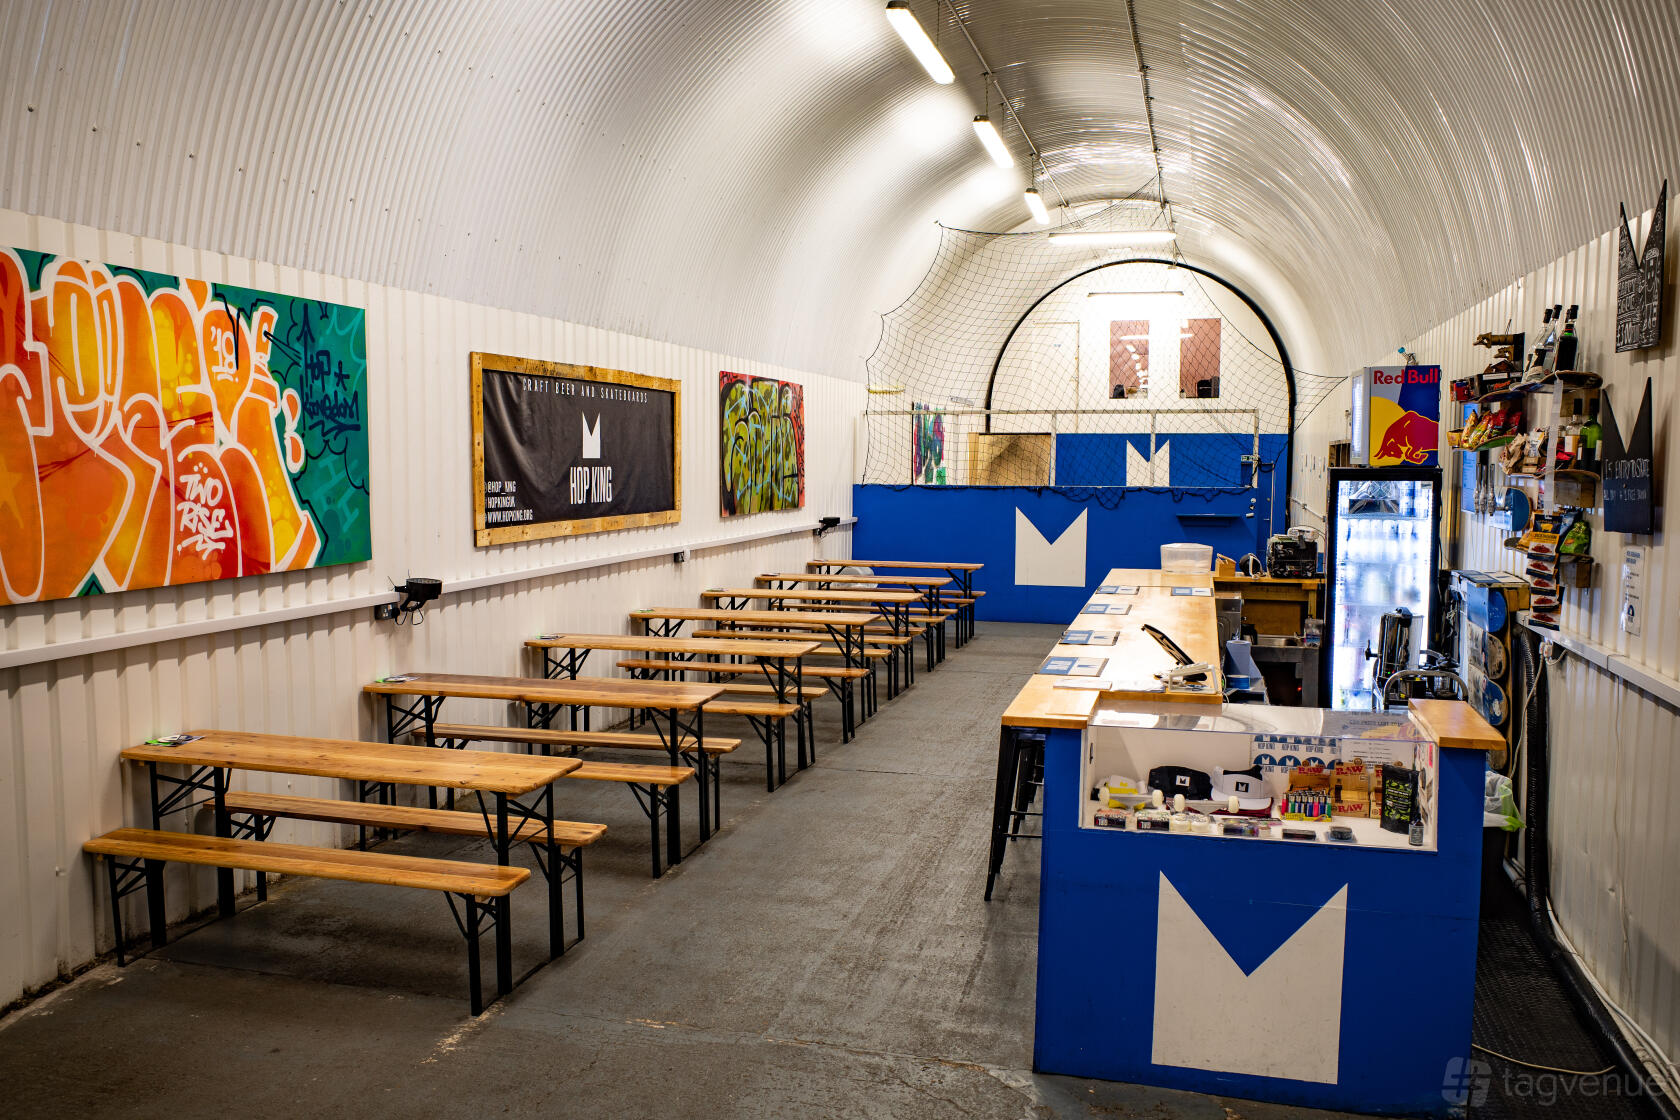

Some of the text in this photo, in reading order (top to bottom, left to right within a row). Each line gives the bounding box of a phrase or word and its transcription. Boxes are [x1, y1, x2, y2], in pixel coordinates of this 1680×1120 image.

[1373, 367, 1439, 385] Red Bull
[522, 377, 648, 404] CRAFT BEER AND SKATEBOARDS
[179, 474, 223, 507] TWO
[570, 466, 613, 505] HOP KING
[1298, 766, 1324, 775] RAW
[1336, 765, 1364, 776] RAW
[1337, 803, 1364, 813] RAW
